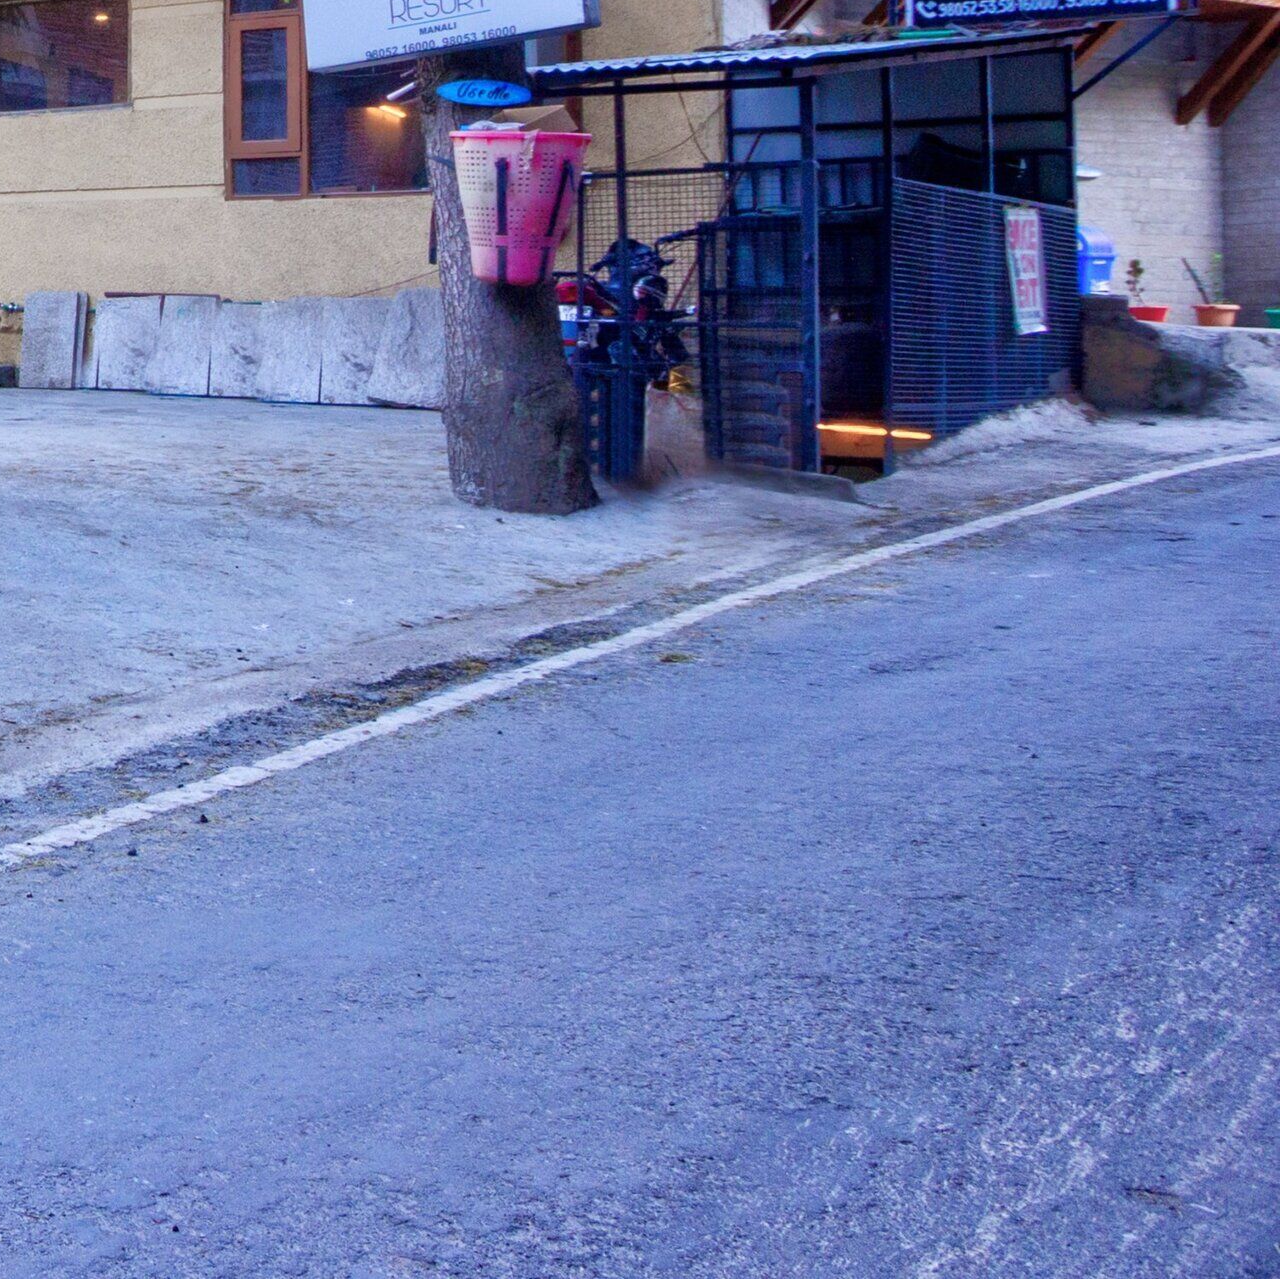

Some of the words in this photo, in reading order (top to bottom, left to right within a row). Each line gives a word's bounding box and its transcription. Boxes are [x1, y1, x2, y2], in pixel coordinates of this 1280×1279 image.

[419, 22, 457, 36] MANALI
[365, 46, 398, 61] 98052
[442, 33, 477, 48] 98053
[482, 25, 517, 41] 16000
